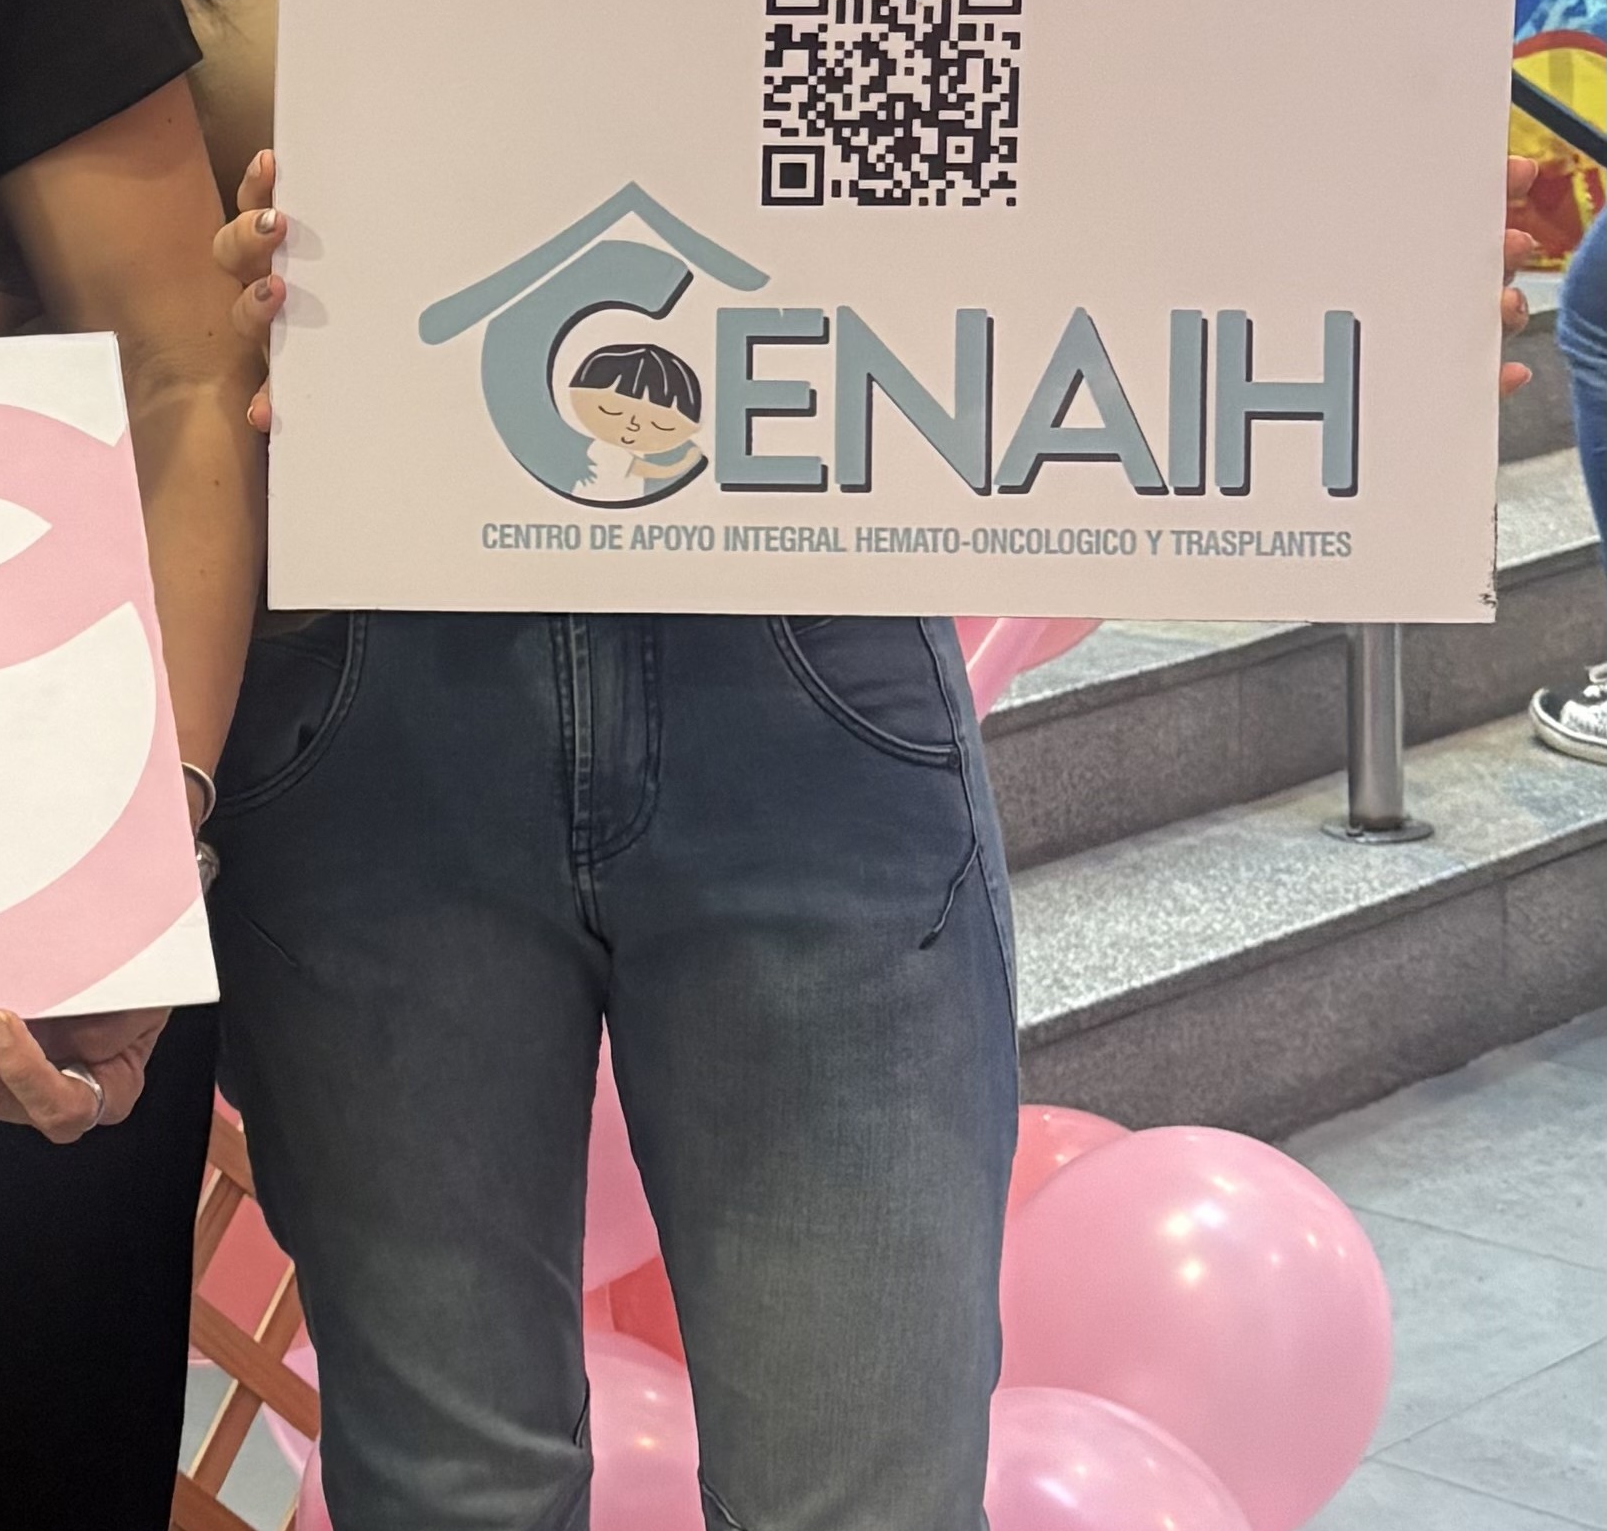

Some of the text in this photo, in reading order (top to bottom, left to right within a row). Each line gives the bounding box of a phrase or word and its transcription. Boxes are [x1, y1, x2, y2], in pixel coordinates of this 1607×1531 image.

[480, 239, 1362, 509] CENAIH
[481, 522, 1354, 558] CENTRO DE APOYO INTEGRAL HEMATO-ONCOLOGICO Y TRASPLANTES
